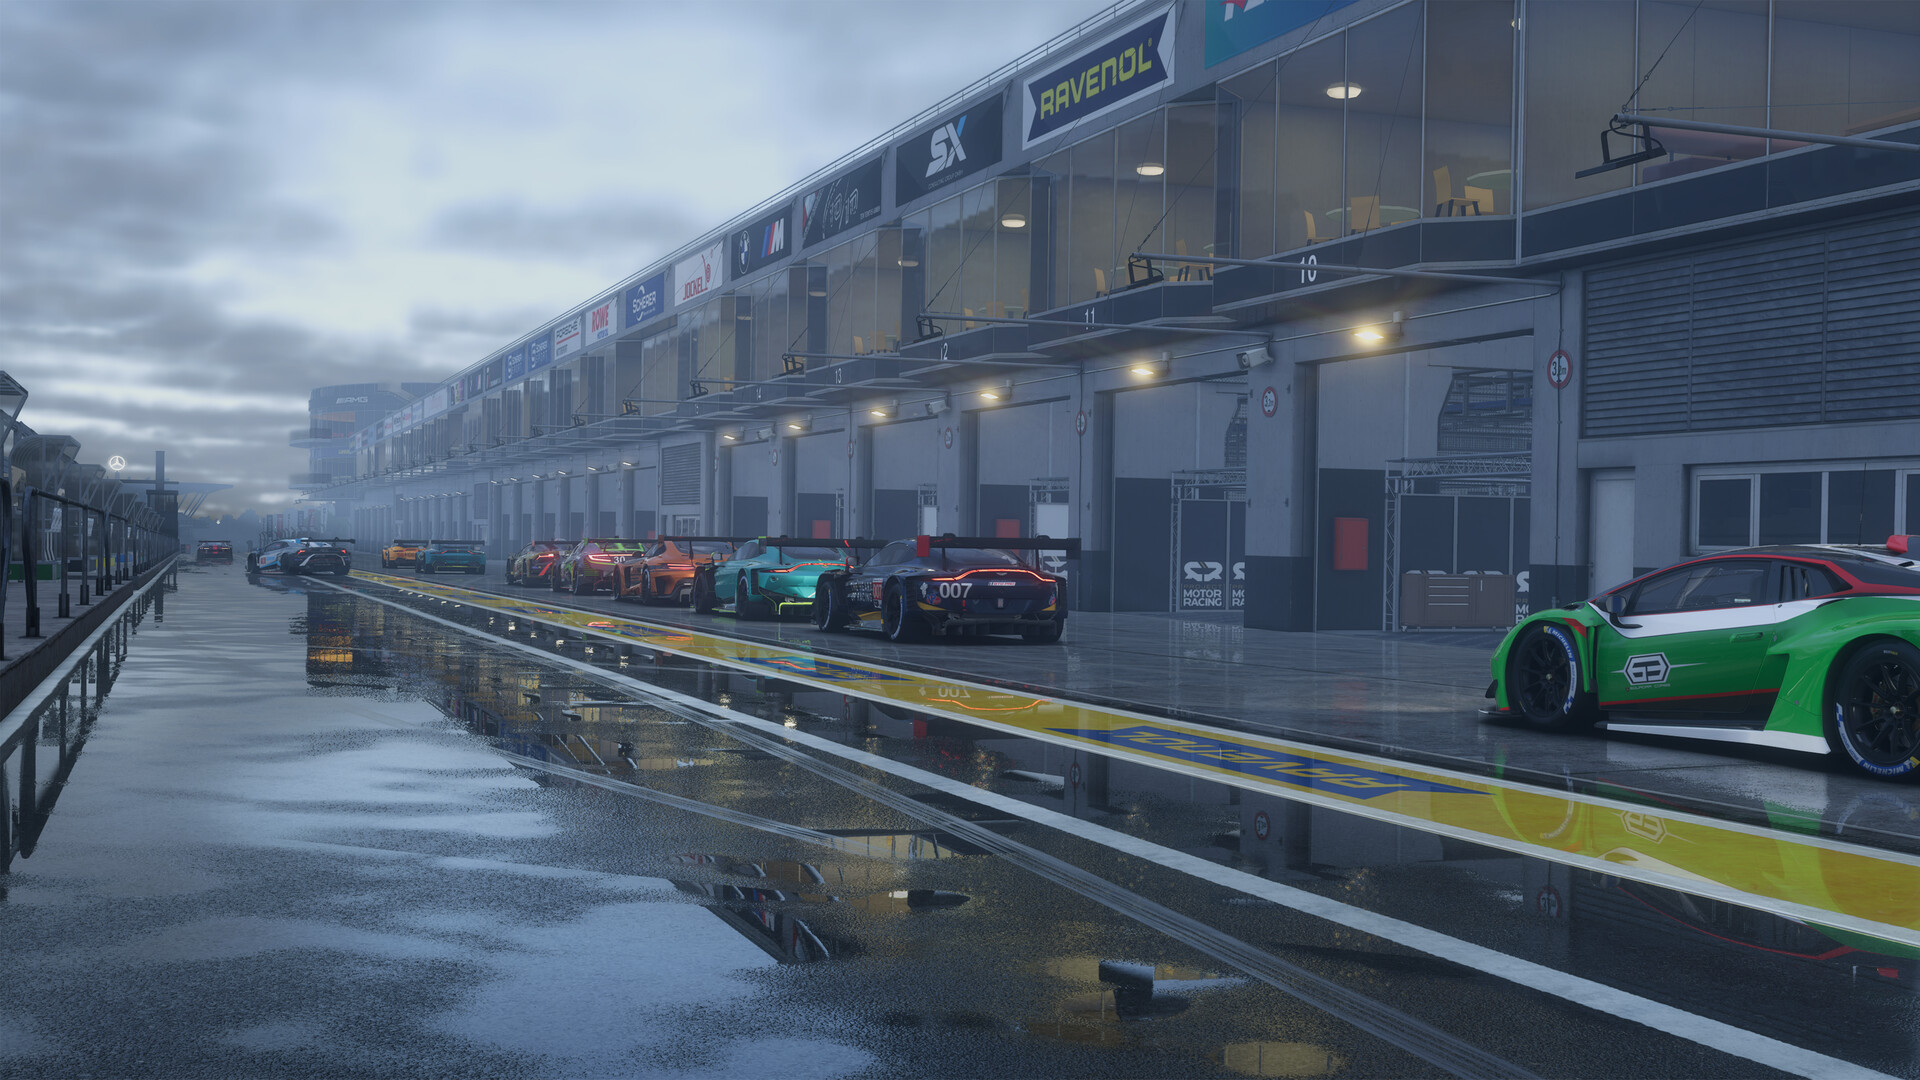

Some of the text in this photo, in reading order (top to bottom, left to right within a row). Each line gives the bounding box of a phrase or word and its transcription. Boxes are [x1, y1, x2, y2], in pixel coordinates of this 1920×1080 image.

[1040, 46, 1152, 120] RAVENOL
[925, 115, 967, 178] SX
[1300, 254, 1317, 283] 10
[592, 304, 609, 333] ROWE
[1085, 307, 1095, 330] 11
[940, 582, 972, 598] 007
[1184, 589, 1222, 598] MOTOR
[1184, 598, 1222, 607] RACING
[1552, 629, 1573, 659] MICHELIN
[1862, 761, 1905, 775] MICHELIN
